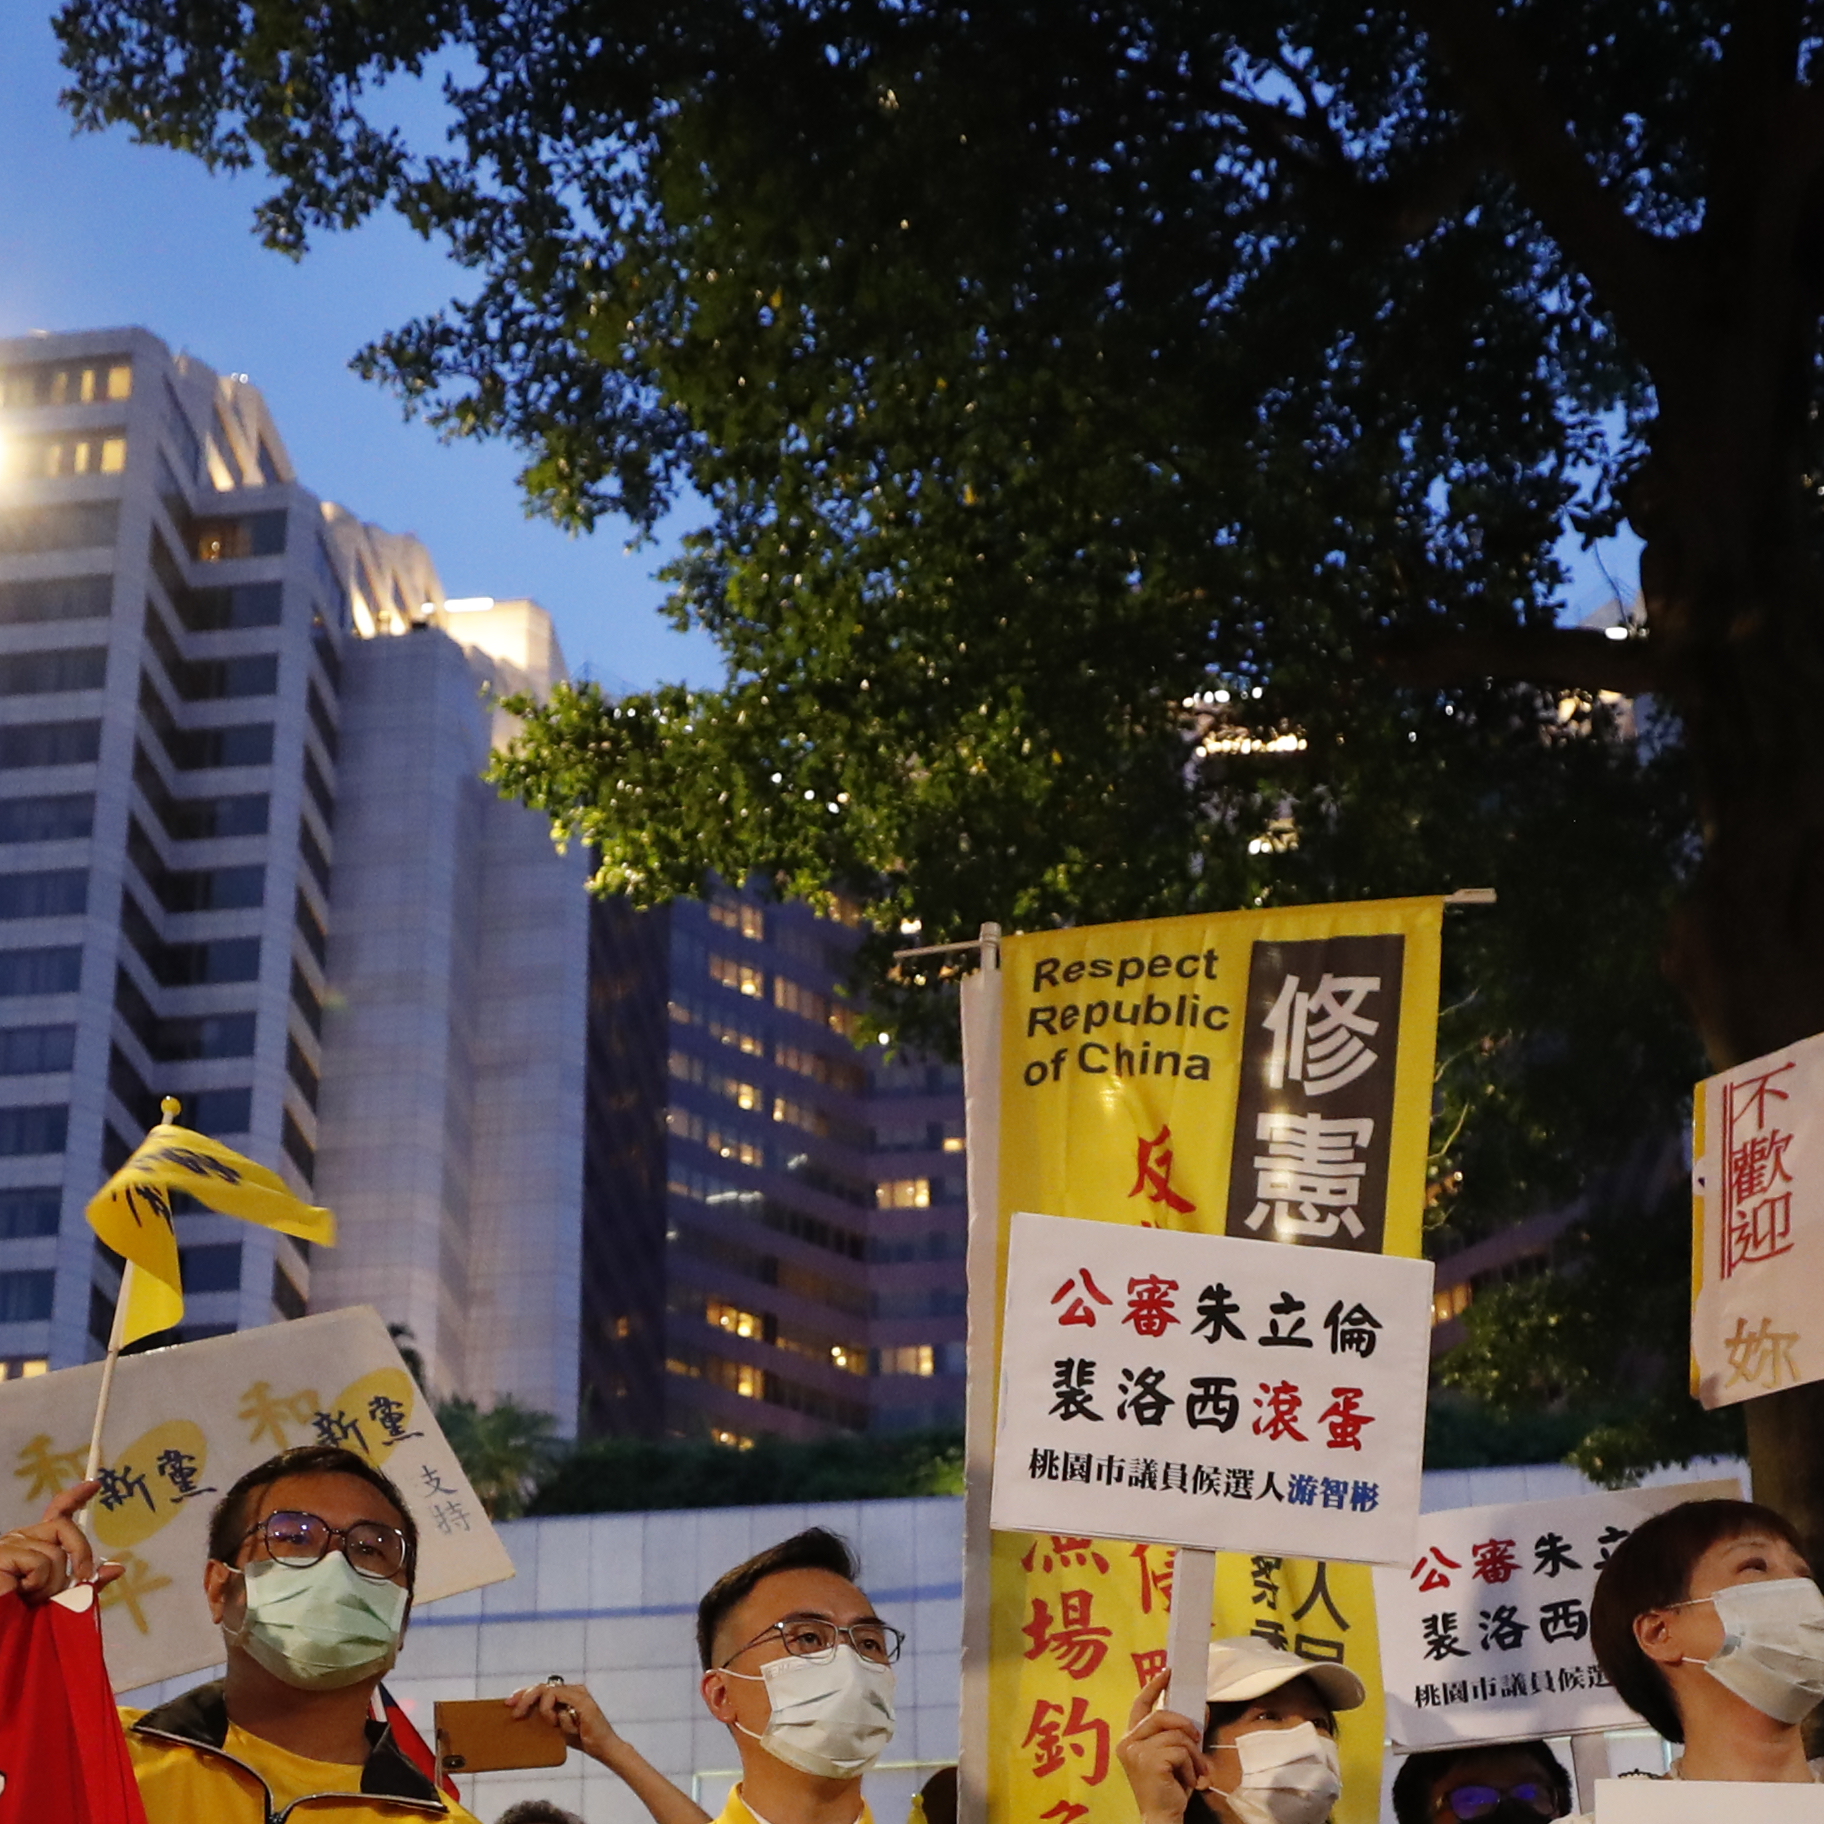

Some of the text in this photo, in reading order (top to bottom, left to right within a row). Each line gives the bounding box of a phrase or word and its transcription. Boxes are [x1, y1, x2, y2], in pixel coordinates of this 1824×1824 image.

[1032, 948, 1220, 992] Respect
[1026, 993, 1230, 1038] Republic
[1022, 1041, 1212, 1087] of China
[1244, 972, 1381, 1240] 修憲
[1050, 1267, 1384, 1360] 公審朱立倫
